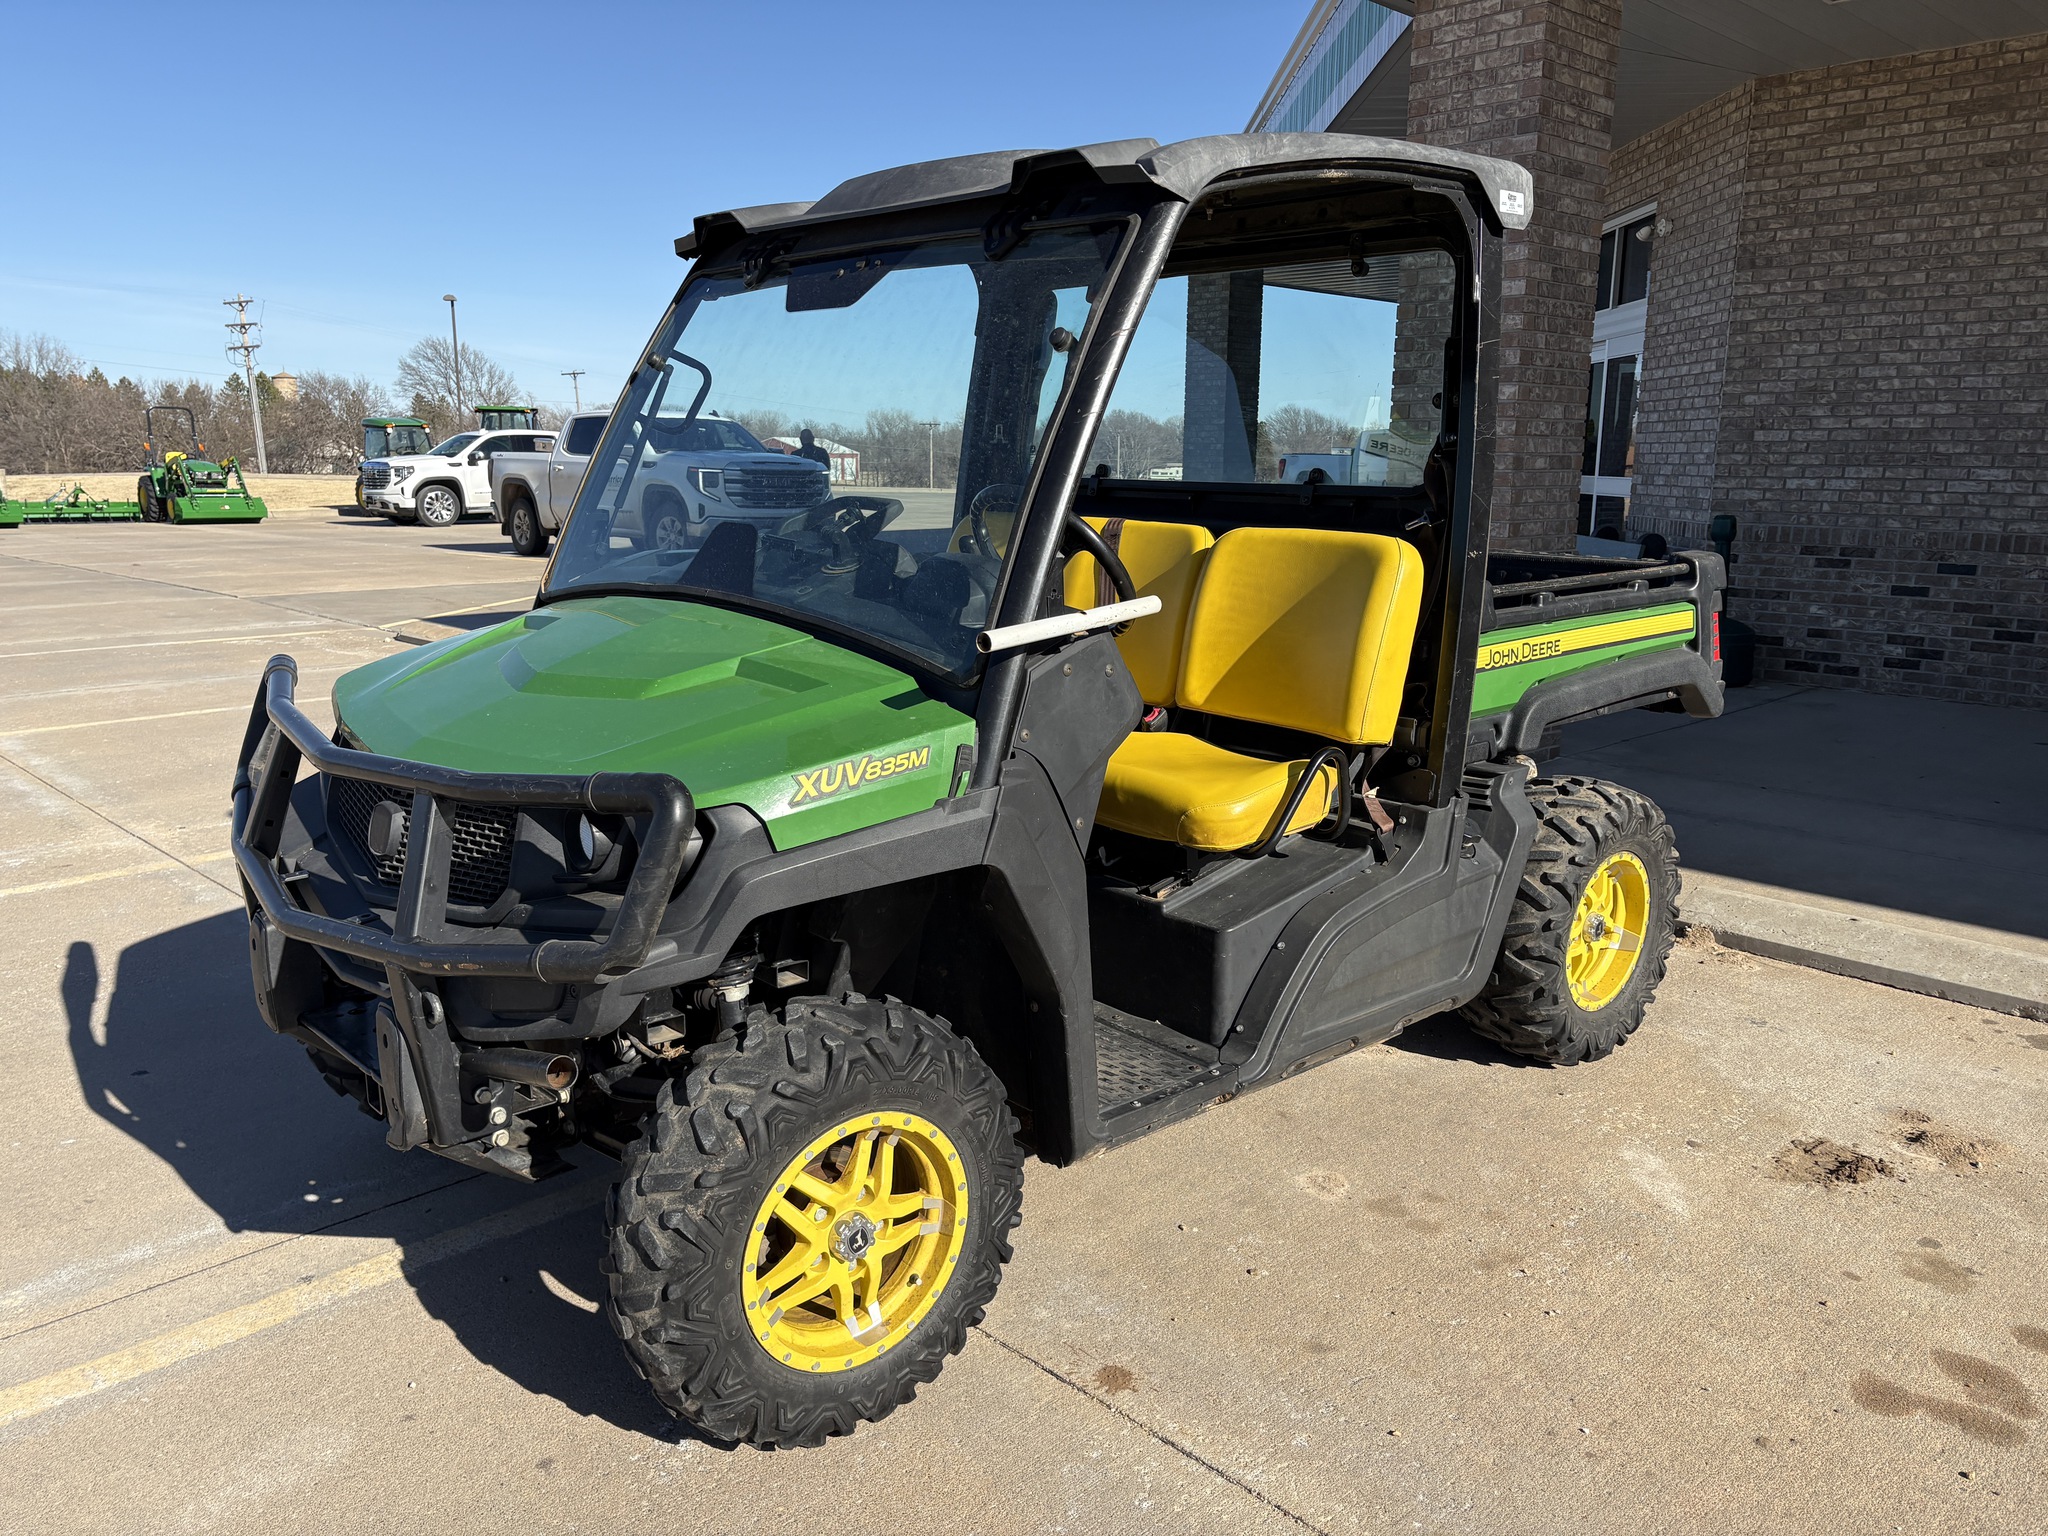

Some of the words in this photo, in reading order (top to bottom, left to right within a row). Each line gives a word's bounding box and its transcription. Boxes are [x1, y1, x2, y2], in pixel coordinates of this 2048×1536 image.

[1485, 648, 1519, 667] JOHN
[1522, 639, 1561, 659] DEERE
[792, 746, 929, 803] XUV835M
